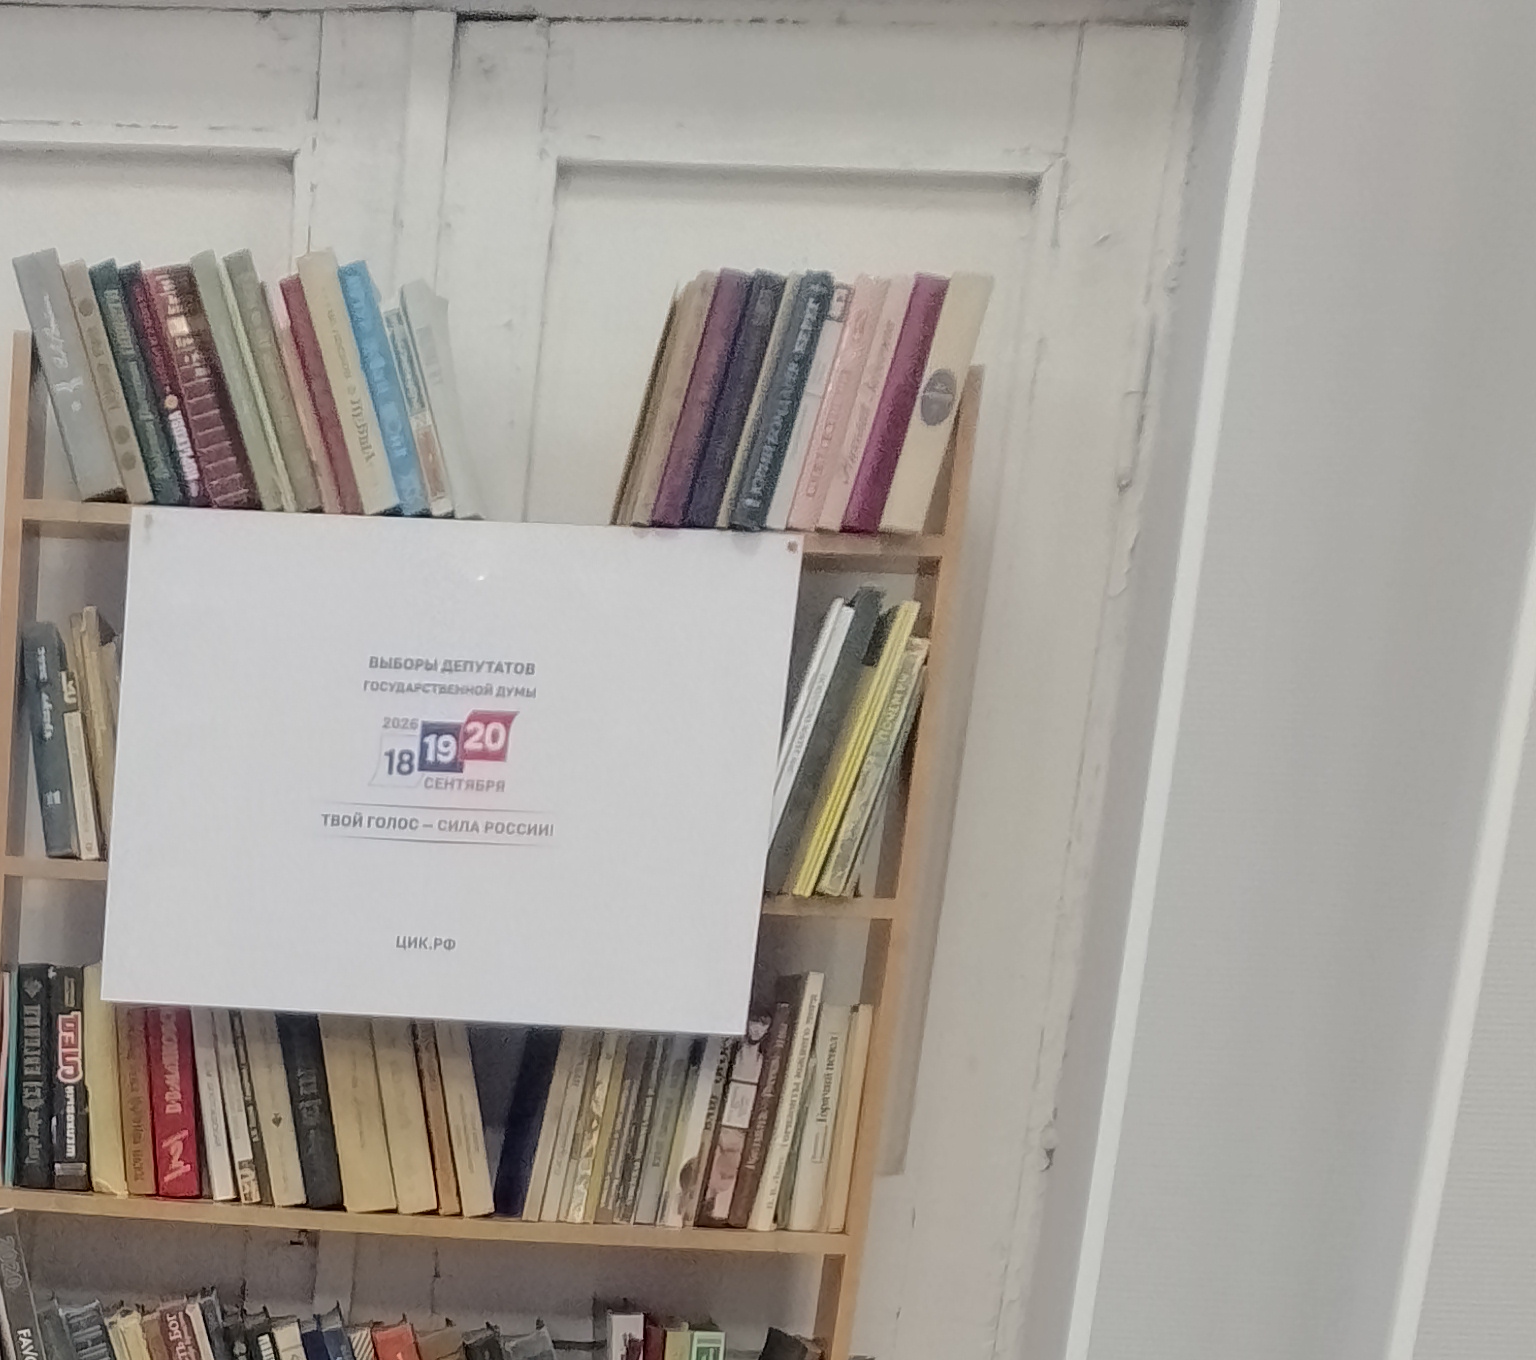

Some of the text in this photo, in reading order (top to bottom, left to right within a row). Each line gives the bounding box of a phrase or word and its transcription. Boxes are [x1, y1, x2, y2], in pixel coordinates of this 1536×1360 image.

[368, 656, 536, 676] ВЫБОРЫ ДЕПУТАТОВ
[364, 680, 537, 698] ГОСУДАРСТВЕННОЙ ДУМЫ
[382, 717, 419, 730] 2026
[384, 721, 507, 776] 18 19 20
[423, 776, 506, 793] СЕНТЯБРЯ
[321, 812, 364, 829] ТВОЙ
[367, 816, 420, 831] ГОЛОС
[437, 819, 480, 834] СИЛА
[484, 821, 555, 837] РОССИИ!
[395, 935, 457, 952] ЦИК.РФ
[56, 1011, 82, 1157] ШЕЛКОВЫЙ СЛЕД
